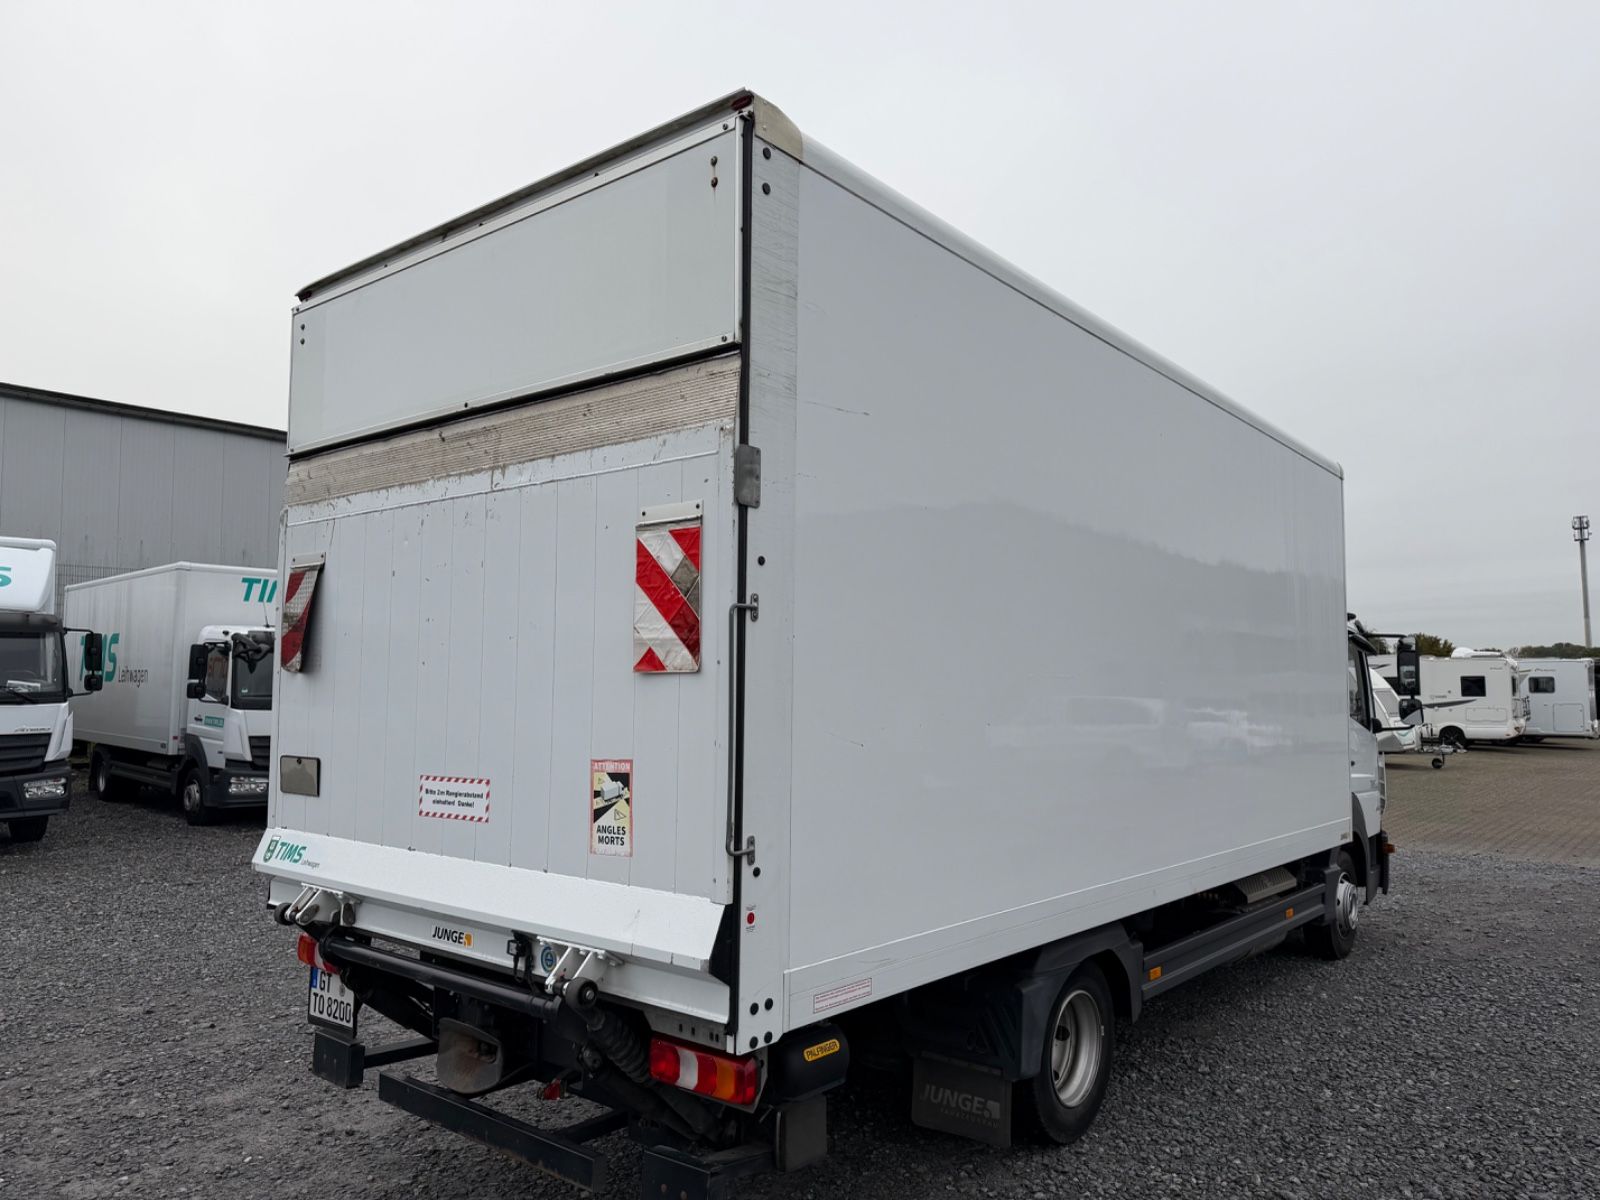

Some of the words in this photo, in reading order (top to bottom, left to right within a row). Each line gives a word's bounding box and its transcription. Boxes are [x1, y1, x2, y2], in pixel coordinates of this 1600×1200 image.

[241, 577, 277, 603] TI
[594, 762, 631, 771] ATTENTION
[596, 825, 626, 836] ANGLES
[598, 836, 625, 846] MORTS
[275, 841, 307, 864] TIMS
[432, 926, 464, 944] JUNGE
[319, 971, 332, 993] GT
[313, 992, 324, 1015] TO
[326, 997, 351, 1023] 8200
[806, 1041, 838, 1060] PALFINGER
[919, 1083, 985, 1114] JUNGE
